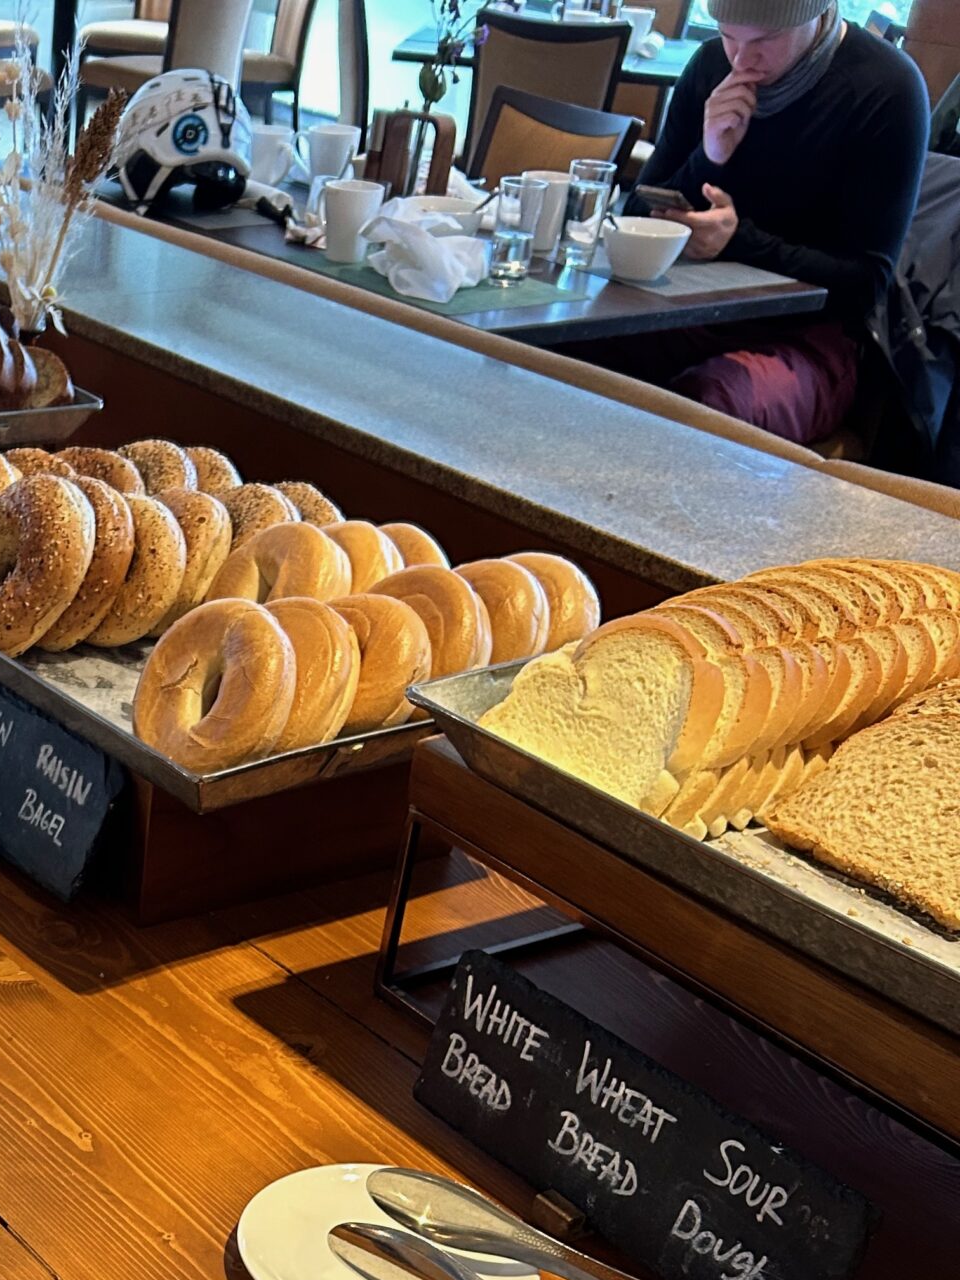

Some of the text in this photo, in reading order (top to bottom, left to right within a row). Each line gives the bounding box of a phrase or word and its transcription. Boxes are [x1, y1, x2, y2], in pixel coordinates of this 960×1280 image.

[17, 744, 93, 847] RAISIN BAGEL
[440, 974, 550, 1112] WHITE BREAD
[547, 1040, 678, 1197] WHEAT BREAD
[703, 1139, 788, 1226] SOUR
